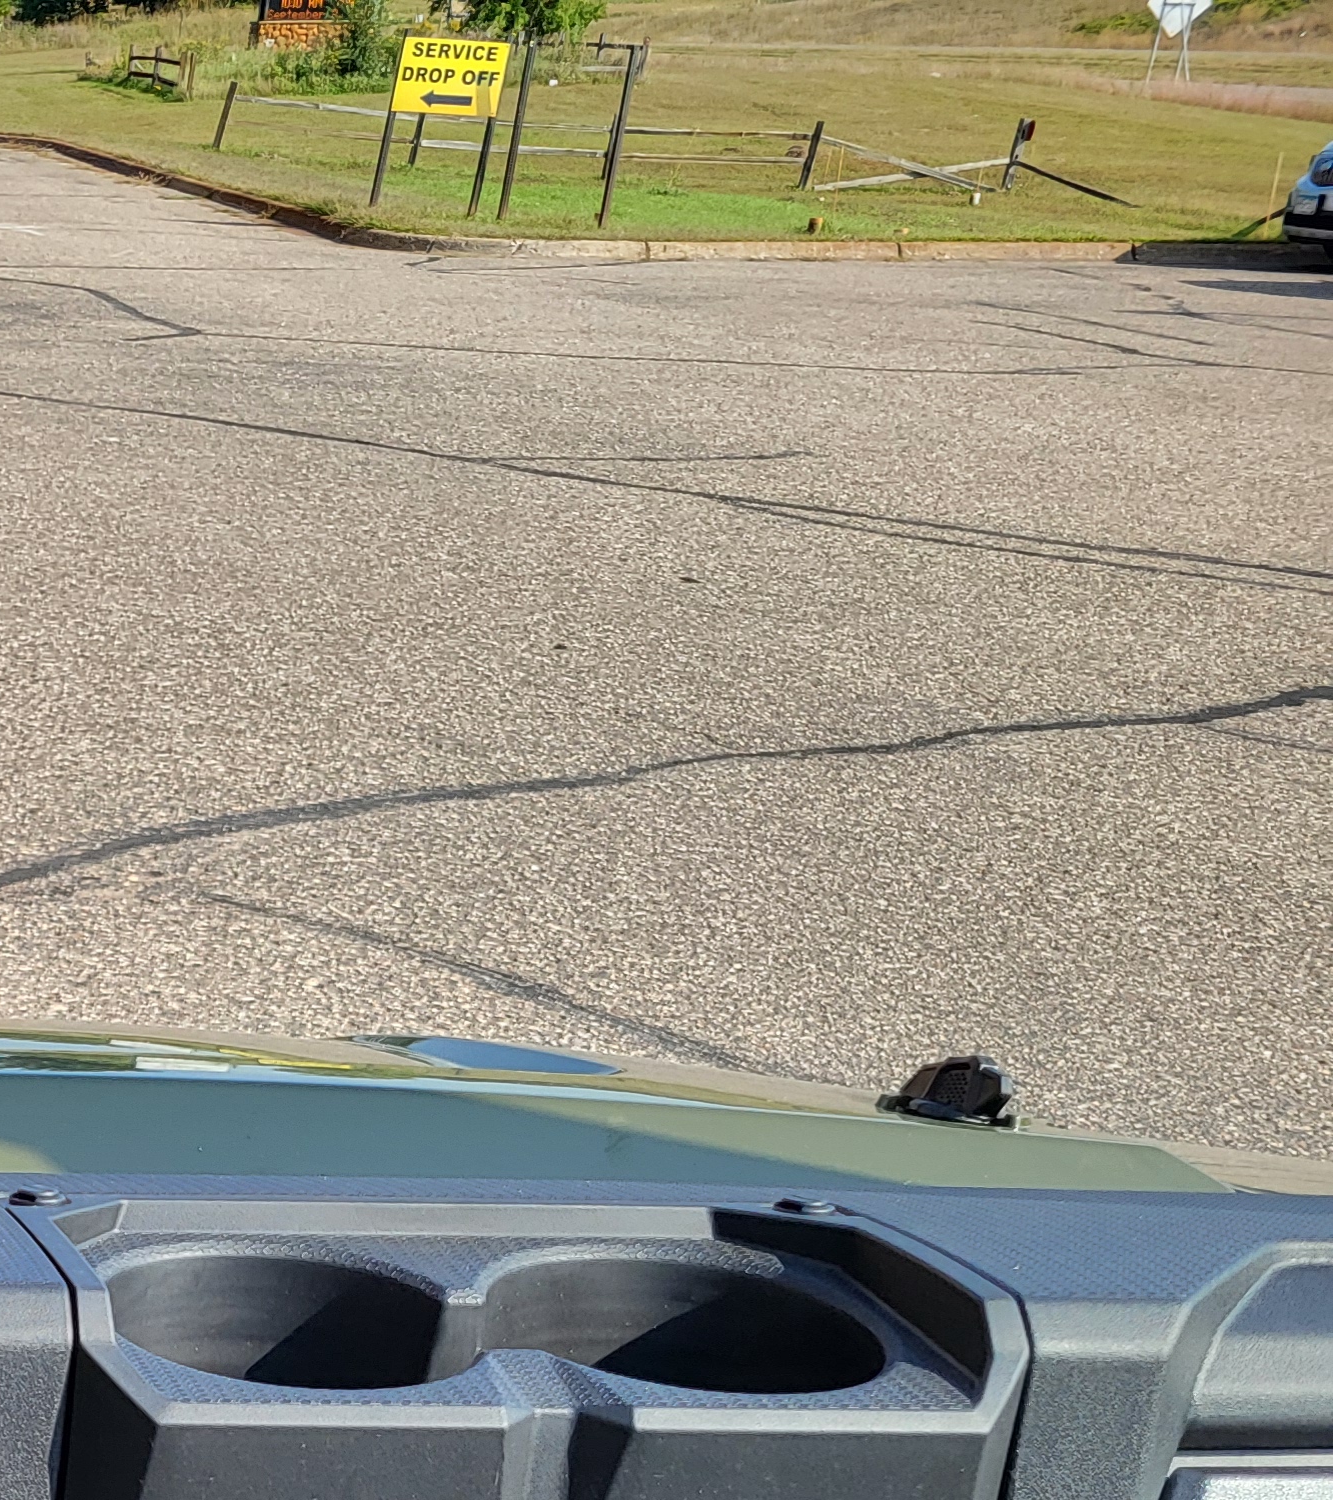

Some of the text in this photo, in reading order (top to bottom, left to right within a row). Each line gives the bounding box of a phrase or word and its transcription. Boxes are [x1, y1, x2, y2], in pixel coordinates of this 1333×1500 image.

[412, 41, 499, 62] SERVICE
[401, 66, 500, 87] DROP OFF
